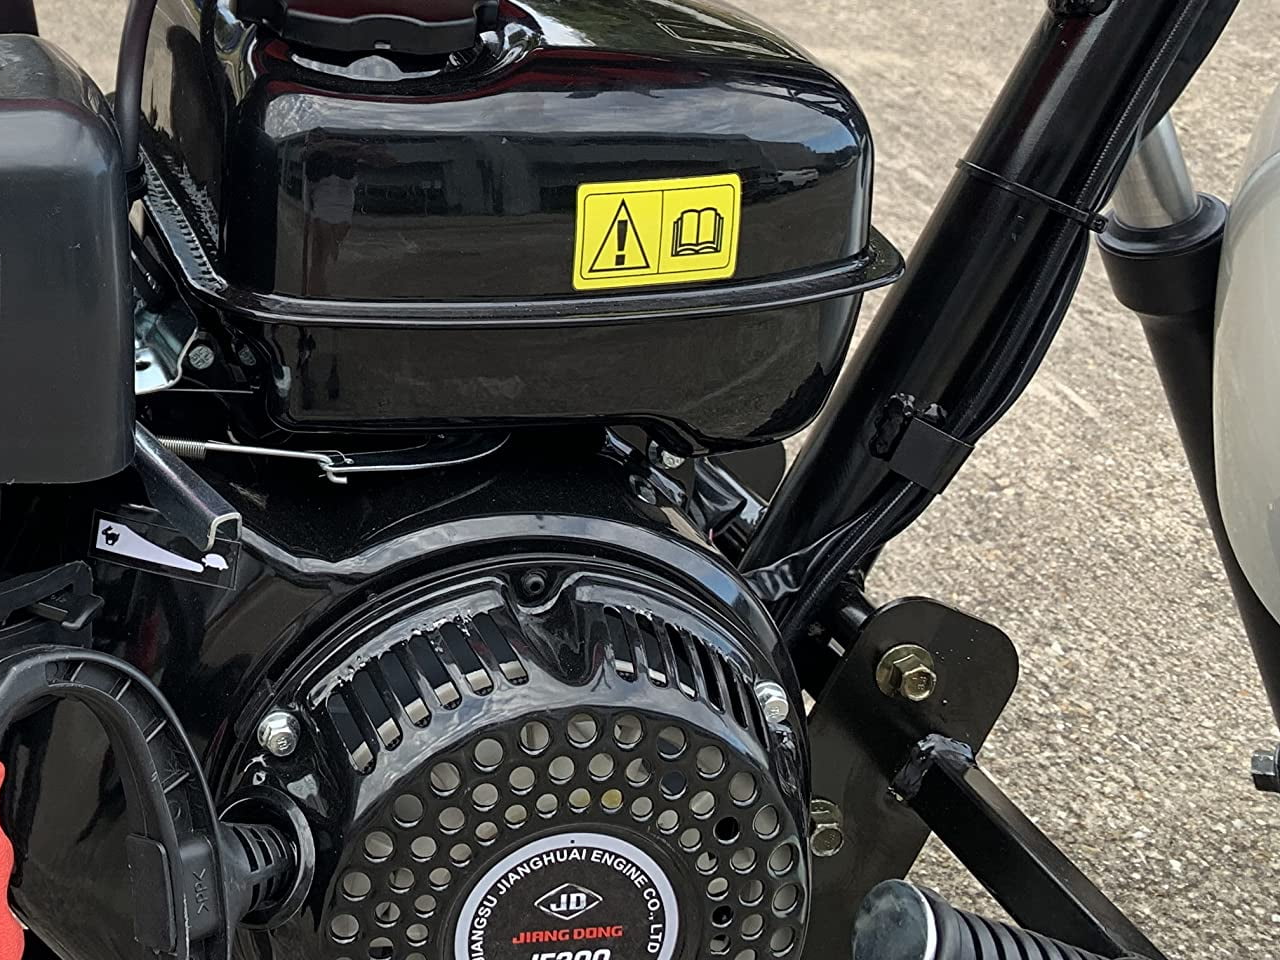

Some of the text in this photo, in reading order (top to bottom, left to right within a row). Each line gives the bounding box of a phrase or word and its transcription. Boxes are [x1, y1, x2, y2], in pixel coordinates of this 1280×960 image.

[496, 848, 586, 895] JIANGHUAI
[590, 849, 648, 889] ENGINE
[647, 923, 663, 954] LTD
[550, 892, 587, 911] JD
[512, 925, 623, 944] JIANG DONG
